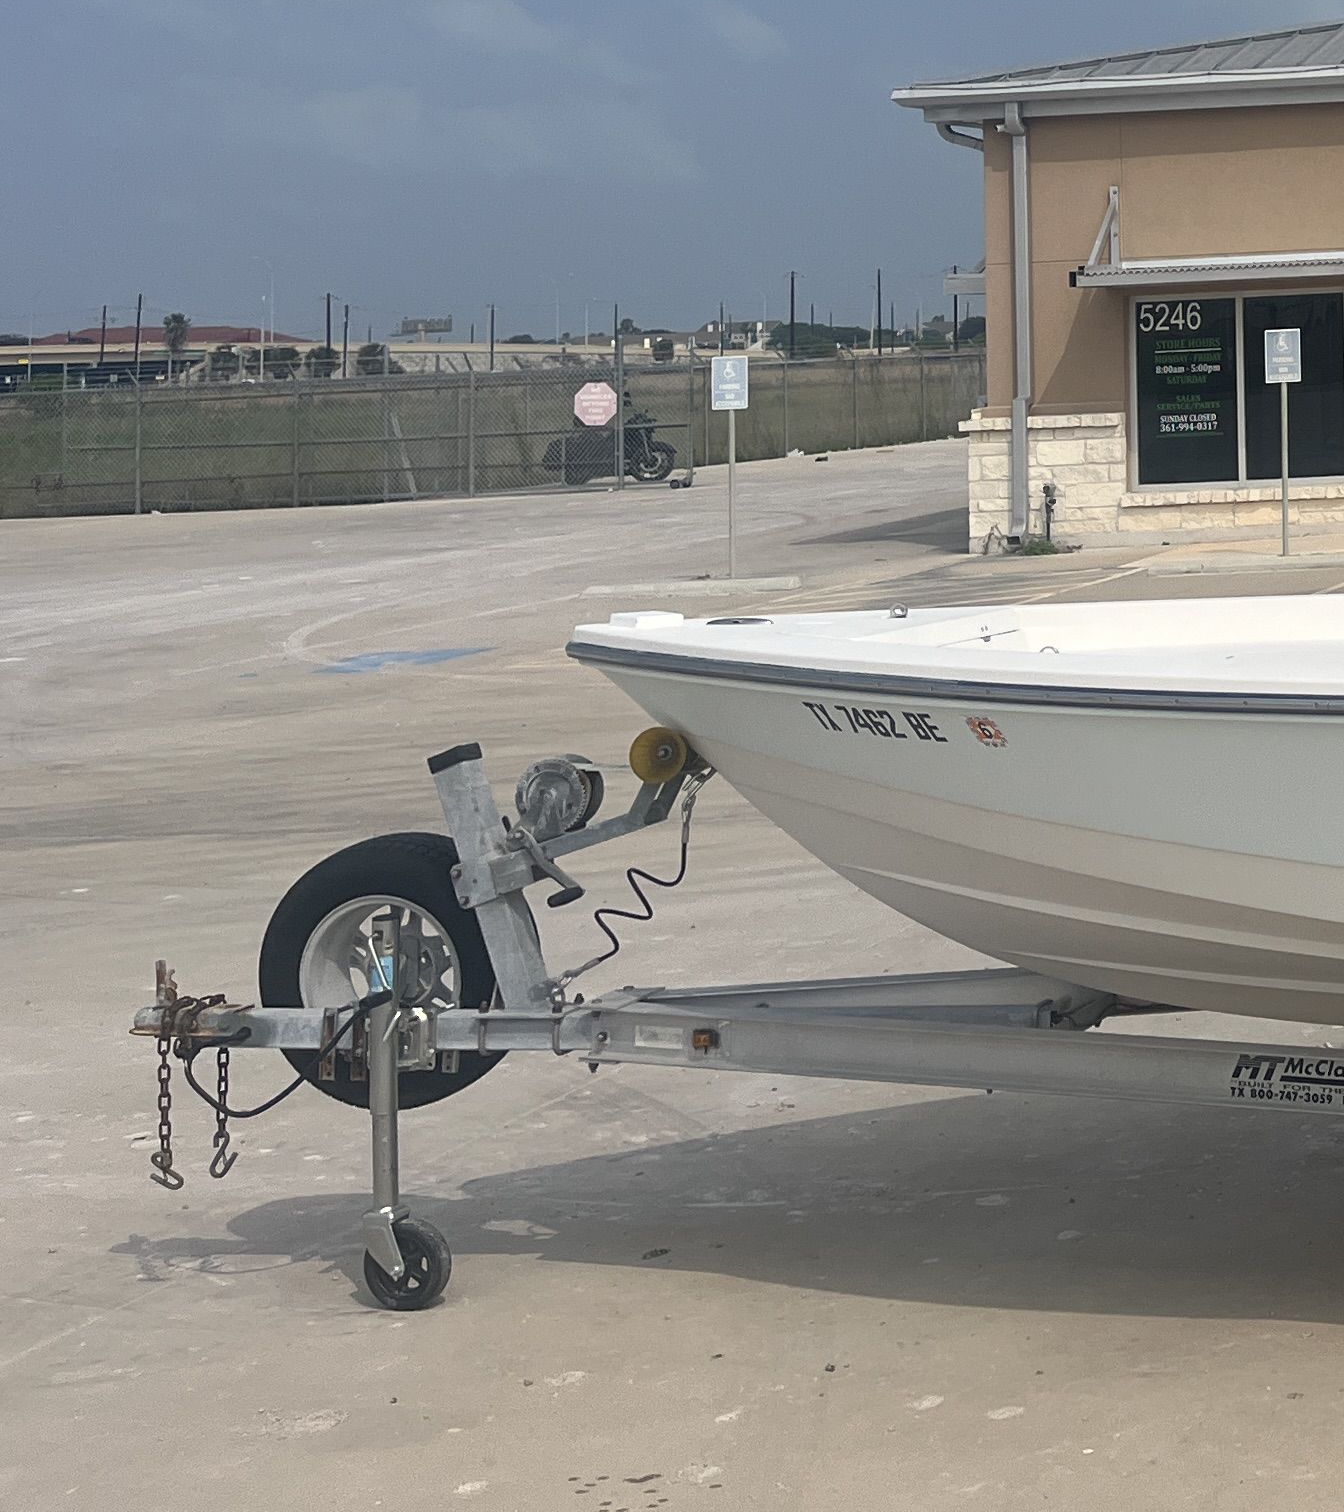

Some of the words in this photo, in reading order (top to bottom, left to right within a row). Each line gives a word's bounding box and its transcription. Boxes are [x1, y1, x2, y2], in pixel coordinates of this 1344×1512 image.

[1139, 302, 1201, 332] 5246
[1156, 339, 1187, 349] STORE
[1188, 337, 1221, 348] HOURS
[1155, 365, 1185, 374] 8:00am
[1190, 363, 1221, 374] 5:00pm
[1166, 375, 1207, 385] SATURDAY
[1159, 414, 1188, 423] SUNDAY
[1189, 413, 1217, 422] CLOSED
[1159, 421, 1218, 433] 361-994-0317
[802, 701, 842, 732] TX
[834, 704, 908, 739] 7462
[902, 710, 949, 743] BE
[1231, 1054, 1287, 1081] MT
[1282, 1084, 1311, 1092] FOR
[1230, 1087, 1245, 1098] TX
[1250, 1089, 1333, 1105] 800-747-3059
